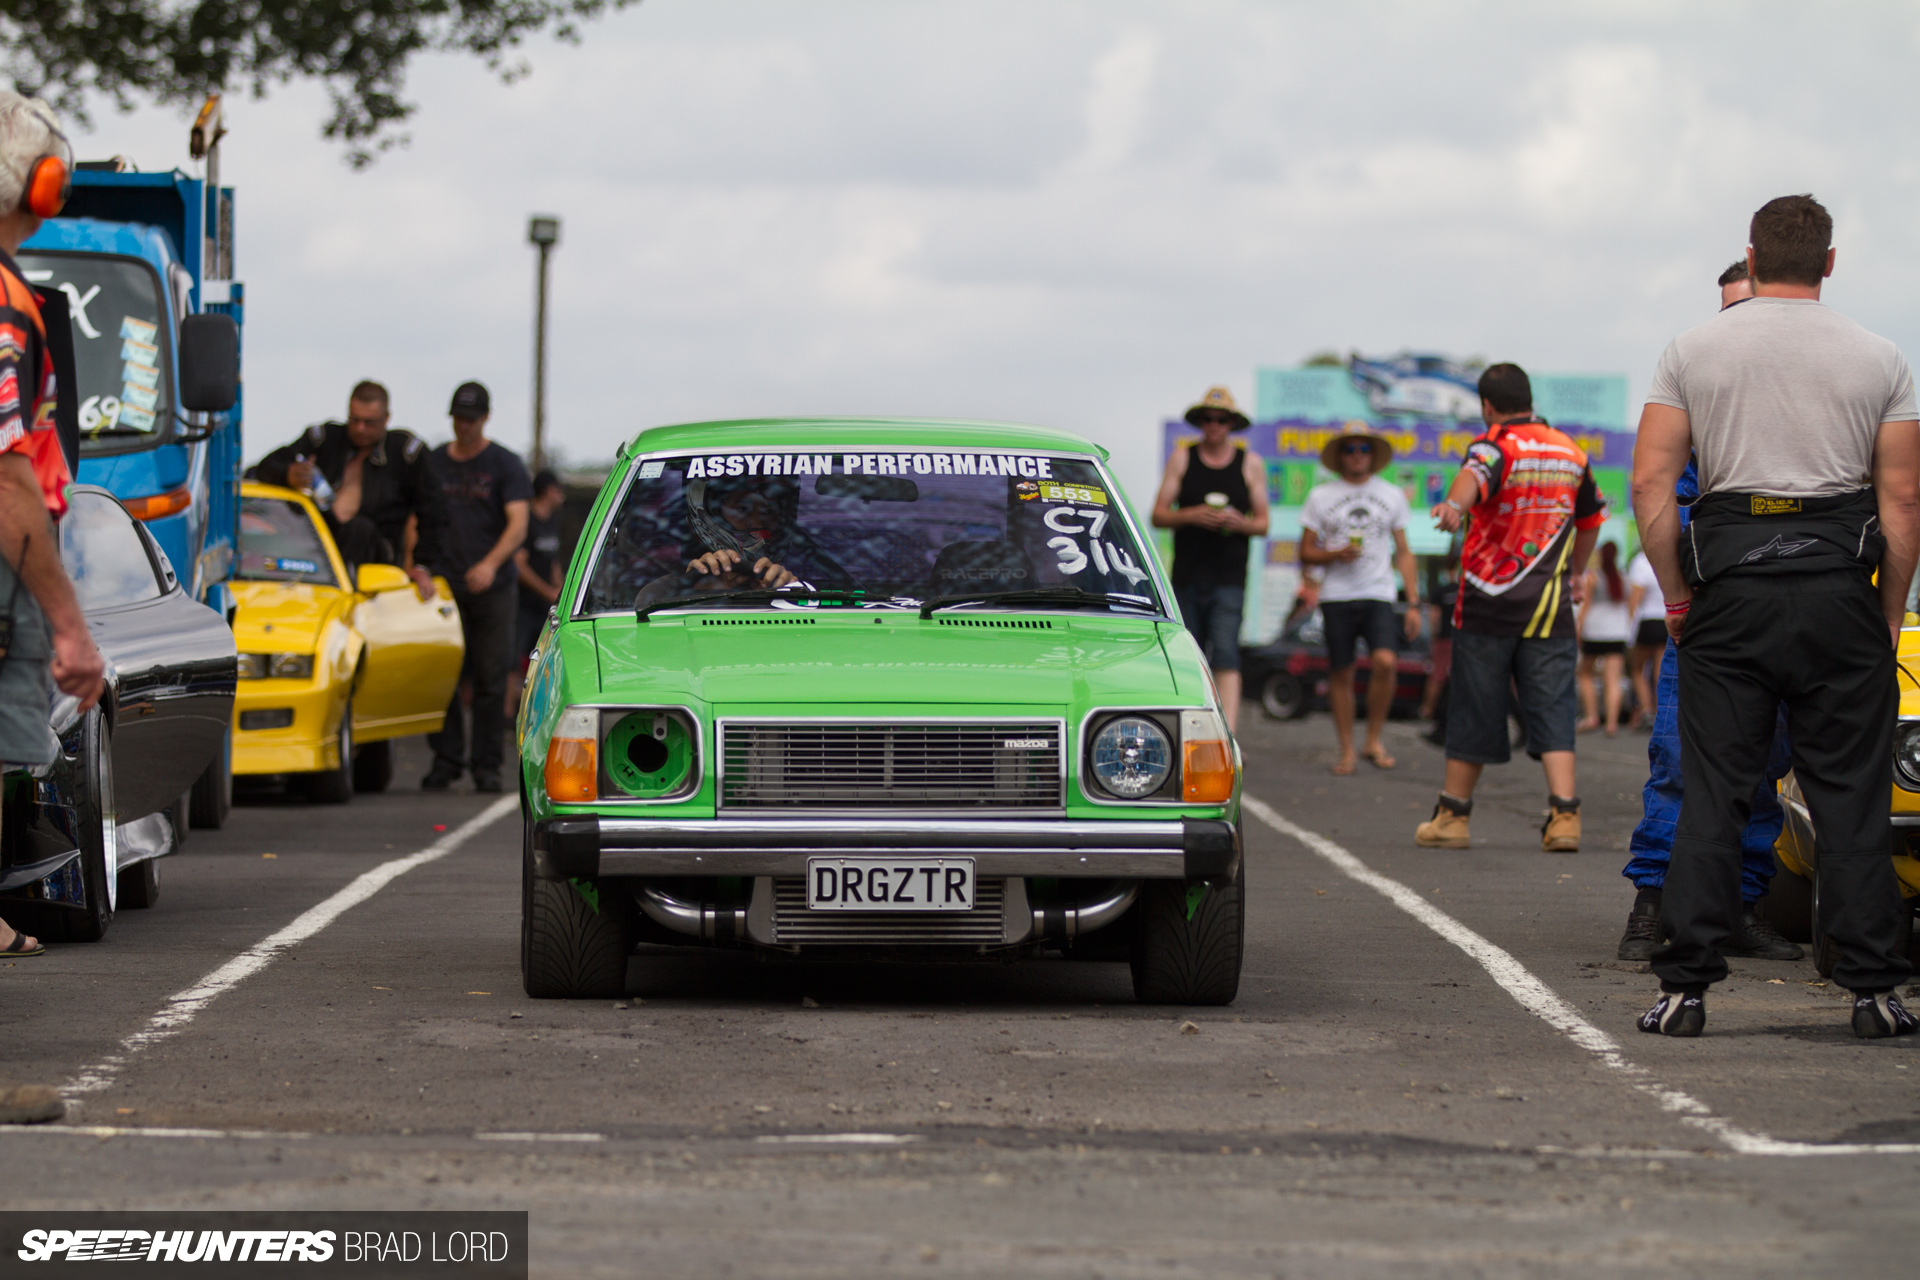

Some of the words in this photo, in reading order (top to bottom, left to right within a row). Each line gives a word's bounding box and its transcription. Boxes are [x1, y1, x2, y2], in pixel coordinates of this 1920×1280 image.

[78, 395, 121, 430] 69
[686, 454, 833, 479] ASSYRIAN
[843, 454, 1053, 479] PERFORMANCE
[1049, 486, 1092, 502] 553
[1043, 506, 1110, 538] C7
[940, 567, 1028, 580] RACEPRO
[1046, 536, 1150, 586] 314
[1004, 739, 1049, 748] mazda
[814, 866, 967, 903] DRGZTR
